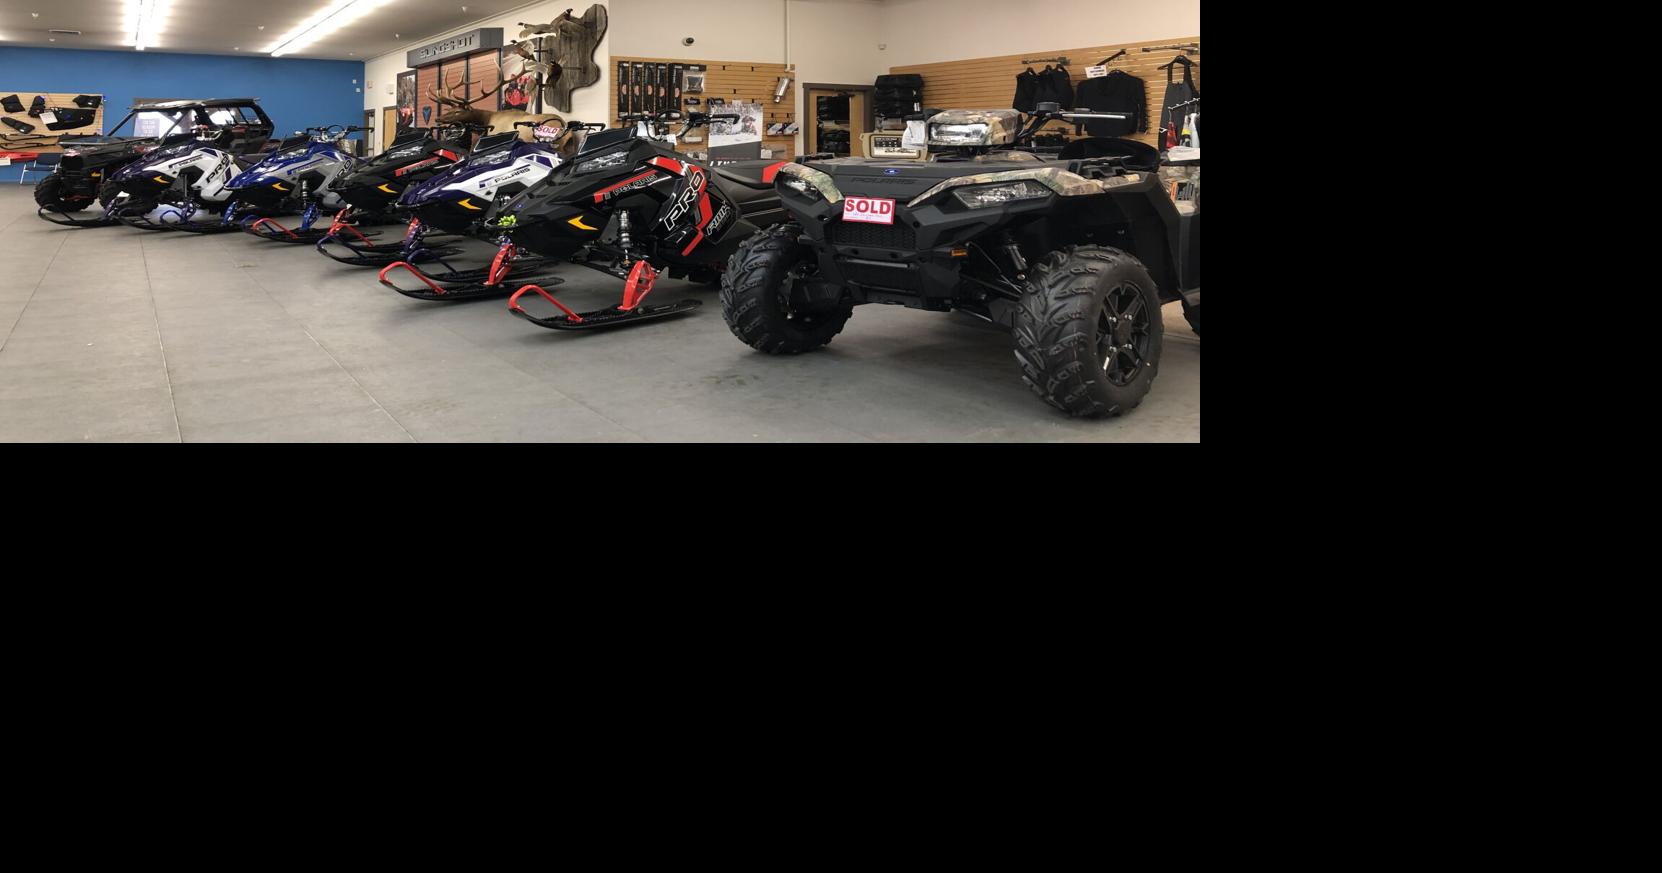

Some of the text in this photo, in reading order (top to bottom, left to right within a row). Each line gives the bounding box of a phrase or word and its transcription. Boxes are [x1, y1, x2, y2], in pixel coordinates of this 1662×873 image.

[537, 125, 558, 134] SOLD
[206, 155, 228, 183] PRO
[494, 167, 531, 183] POLARIS
[613, 174, 658, 196] POLARIS
[663, 170, 704, 231] PRO
[845, 199, 891, 215] SOLD
